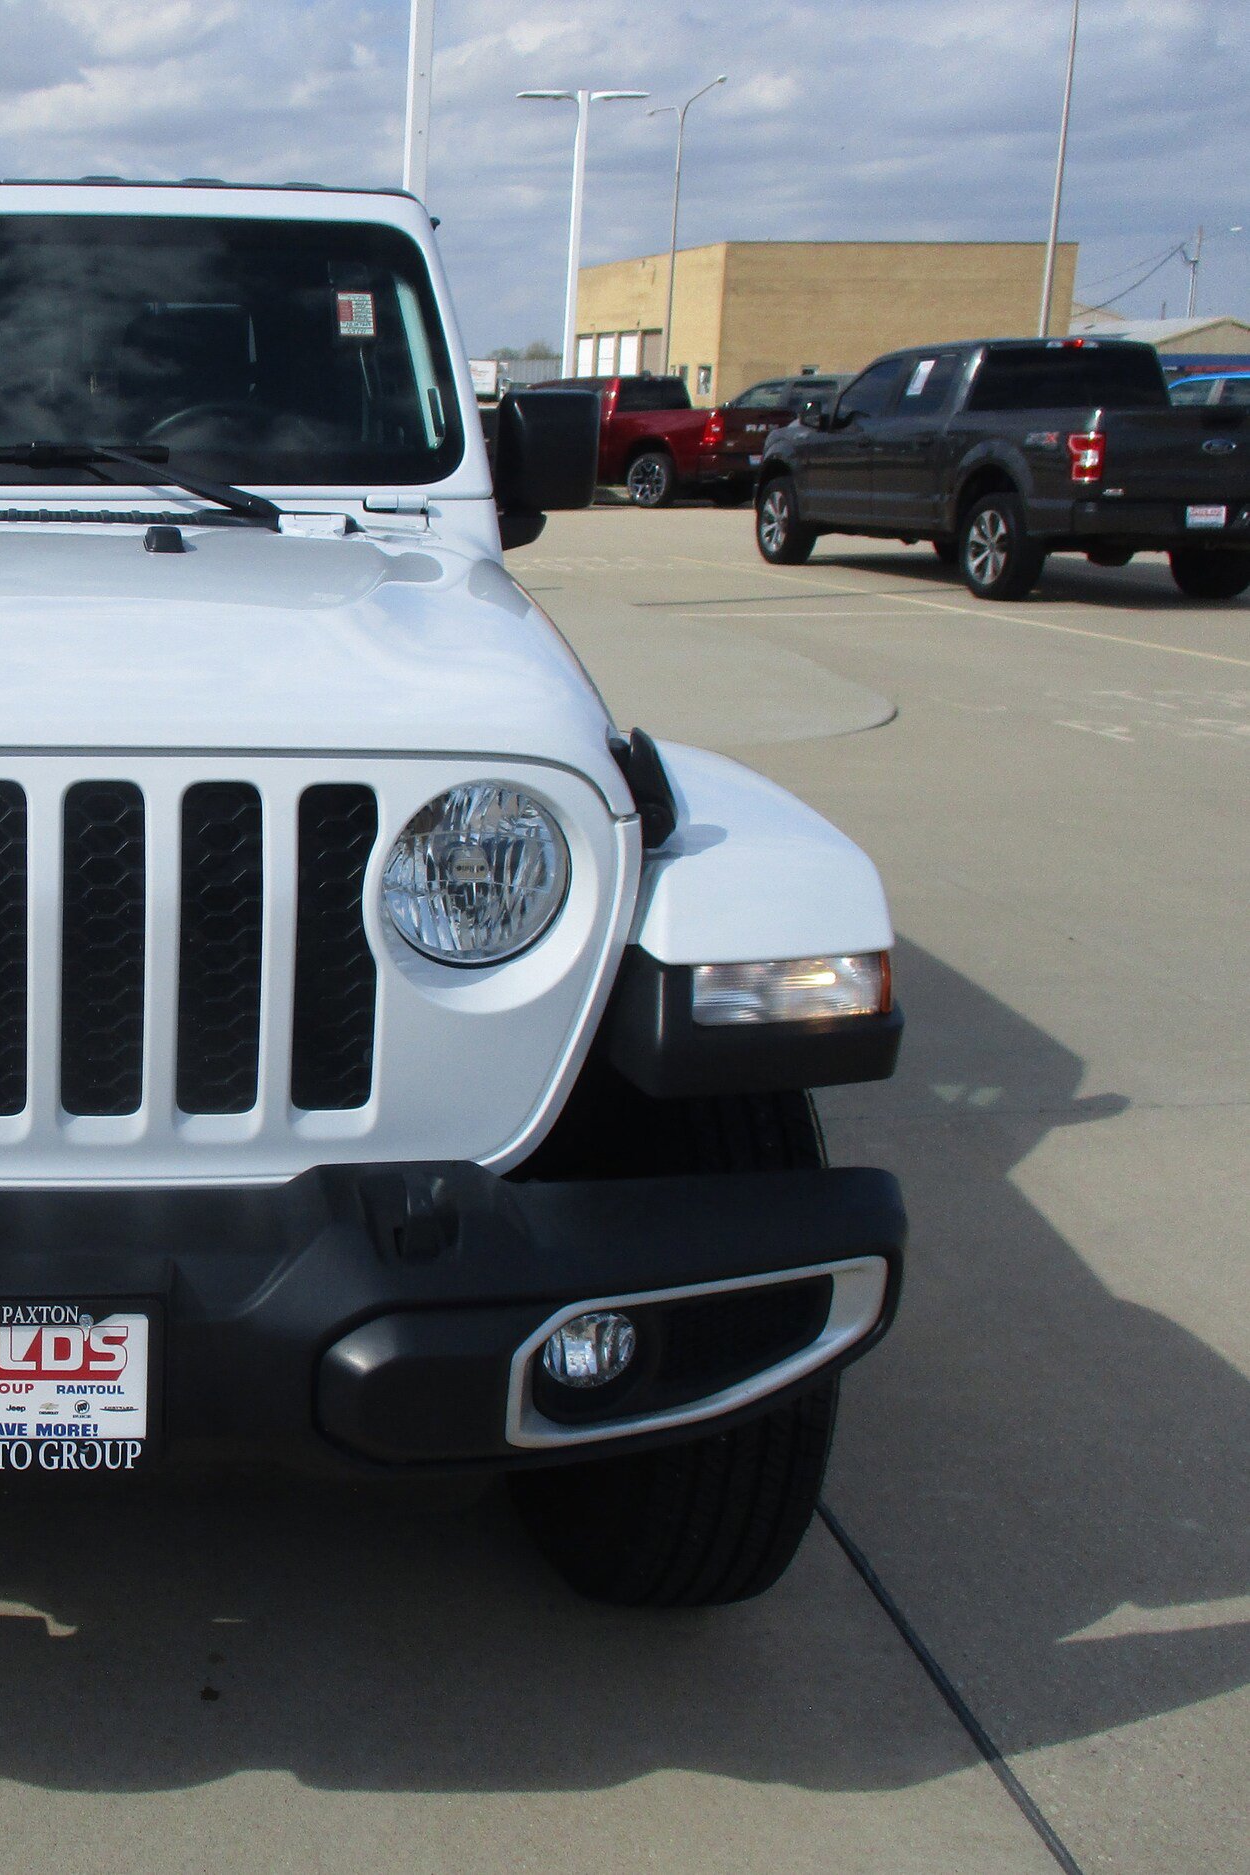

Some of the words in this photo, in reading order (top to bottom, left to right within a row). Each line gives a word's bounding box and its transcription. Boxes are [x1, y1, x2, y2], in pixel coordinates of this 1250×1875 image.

[1, 1305, 80, 1325] PAXTON
[56, 1384, 125, 1395] RANTOUL
[5, 1404, 26, 1413] Jeep
[35, 1423, 99, 1437] MORE!
[38, 1440, 142, 1471] GROUP
